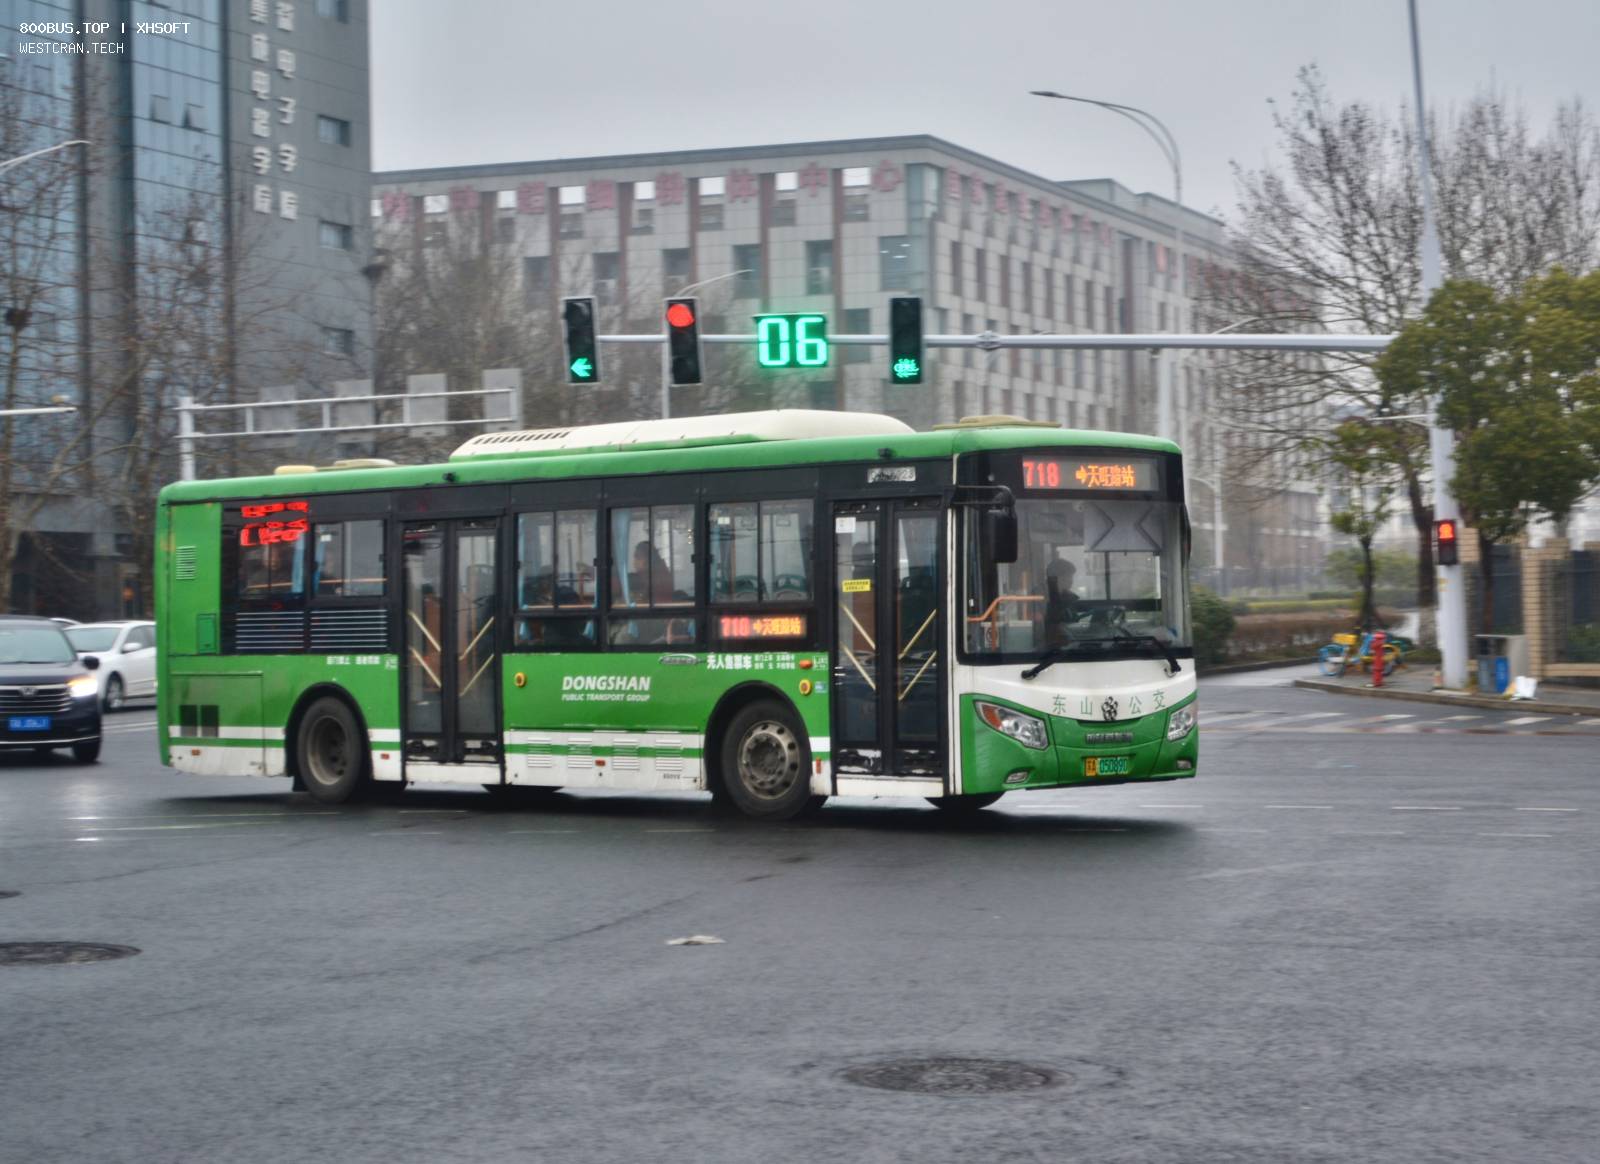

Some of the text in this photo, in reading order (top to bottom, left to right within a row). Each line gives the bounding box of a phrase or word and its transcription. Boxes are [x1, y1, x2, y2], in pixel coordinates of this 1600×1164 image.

[758, 317, 827, 366] 06
[561, 675, 652, 691] DONGSHAN
[561, 693, 651, 702] PUBLIC TRANSPORT GROUP
[1052, 689, 1166, 716] 东山 公交
